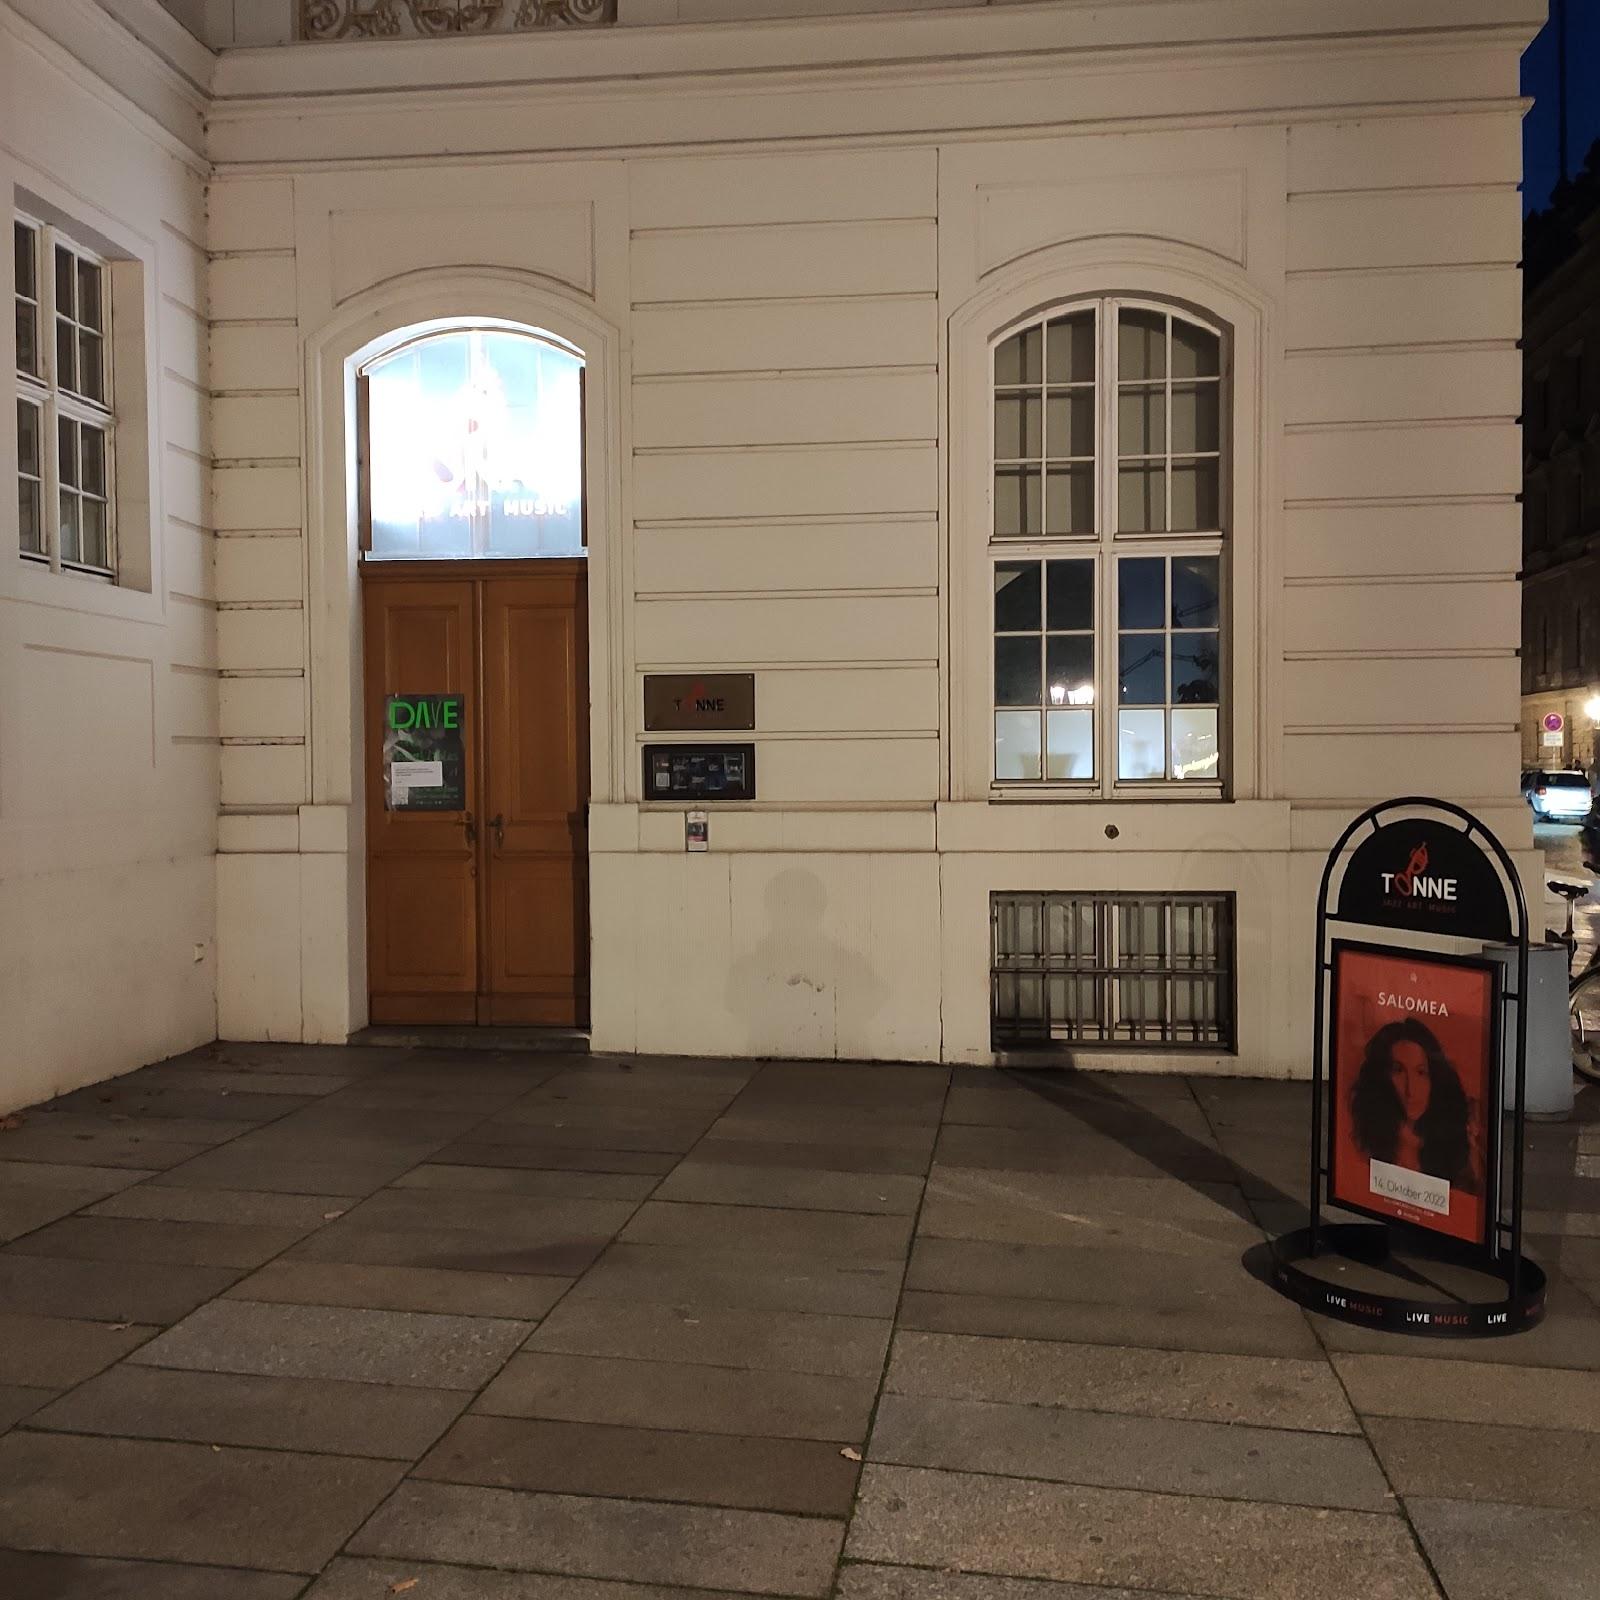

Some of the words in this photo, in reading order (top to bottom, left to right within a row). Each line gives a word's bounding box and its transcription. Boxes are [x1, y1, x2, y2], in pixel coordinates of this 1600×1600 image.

[503, 499, 568, 516] MUSIC
[389, 701, 458, 729] DAVE
[1377, 992, 1449, 1017] SALOMEA
[1387, 1181, 1422, 1200] Oktober
[1423, 1190, 1446, 1208] 2022
[1326, 1293, 1347, 1308] LIVE
[1350, 1300, 1383, 1316] MUSIC
[1406, 1312, 1430, 1323] LIVE
[1434, 1314, 1470, 1325] MUSIC
[1488, 1312, 1508, 1324] LIVE
